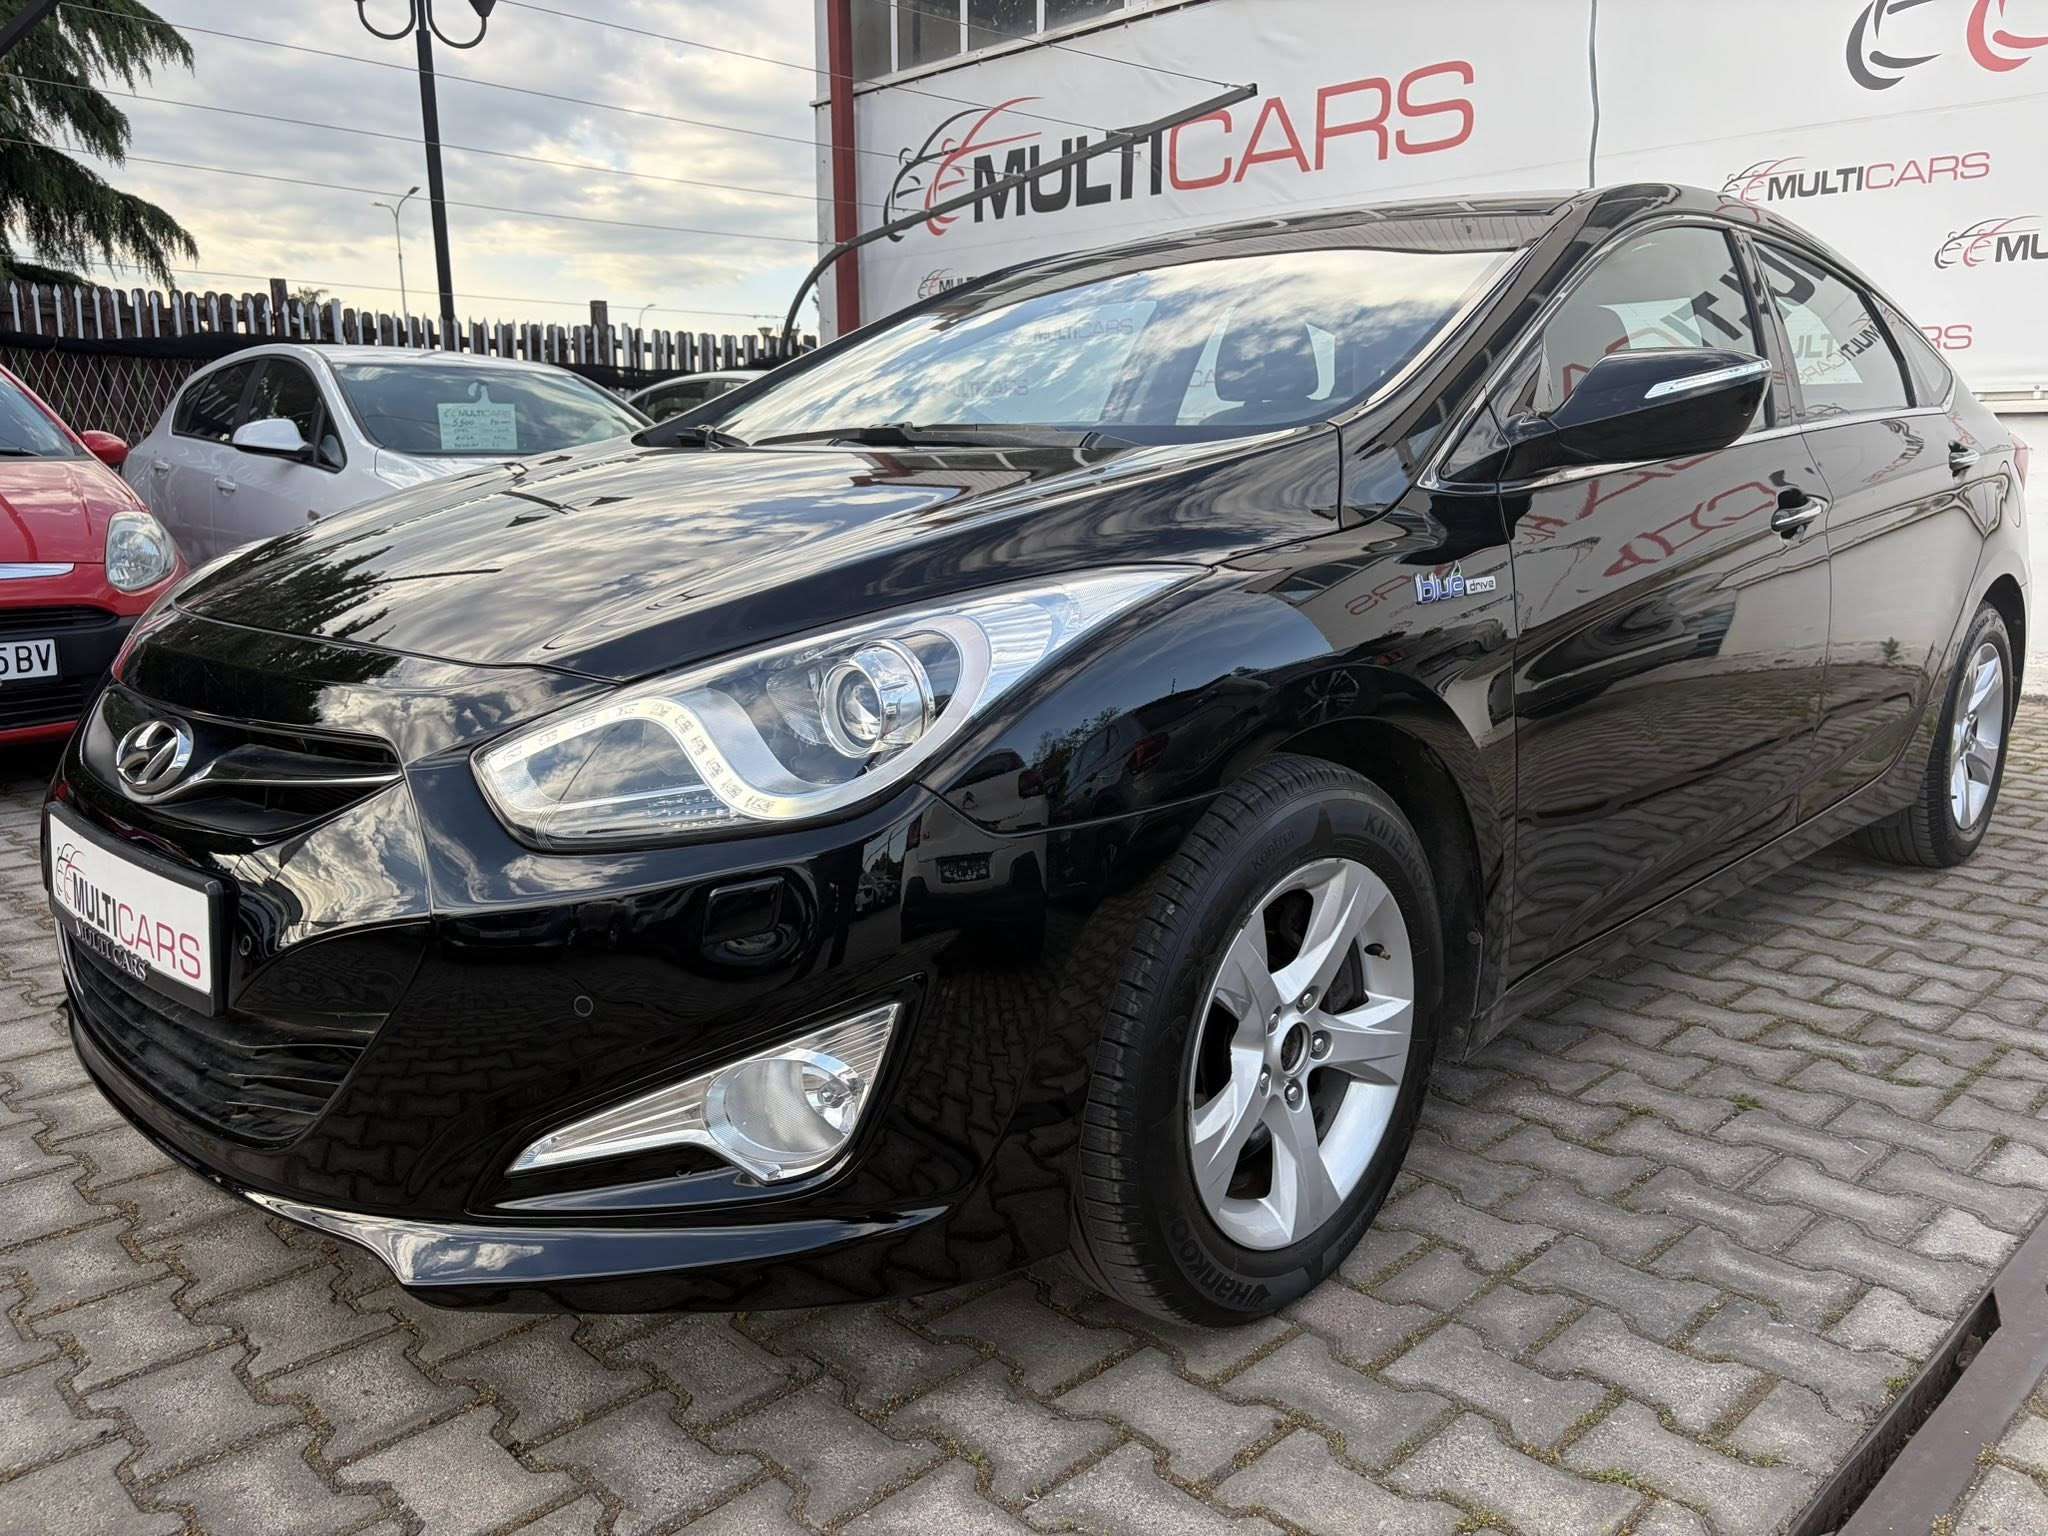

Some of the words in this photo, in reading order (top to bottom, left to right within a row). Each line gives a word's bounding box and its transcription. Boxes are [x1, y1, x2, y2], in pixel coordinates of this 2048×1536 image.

[974, 60, 1475, 223] MULTICARS
[1767, 151, 1990, 201] MULTICARS
[1414, 563, 1465, 604] blue
[1469, 580, 1495, 592] drive
[73, 870, 201, 980] MULTICARS
[112, 944, 147, 981] CARS
